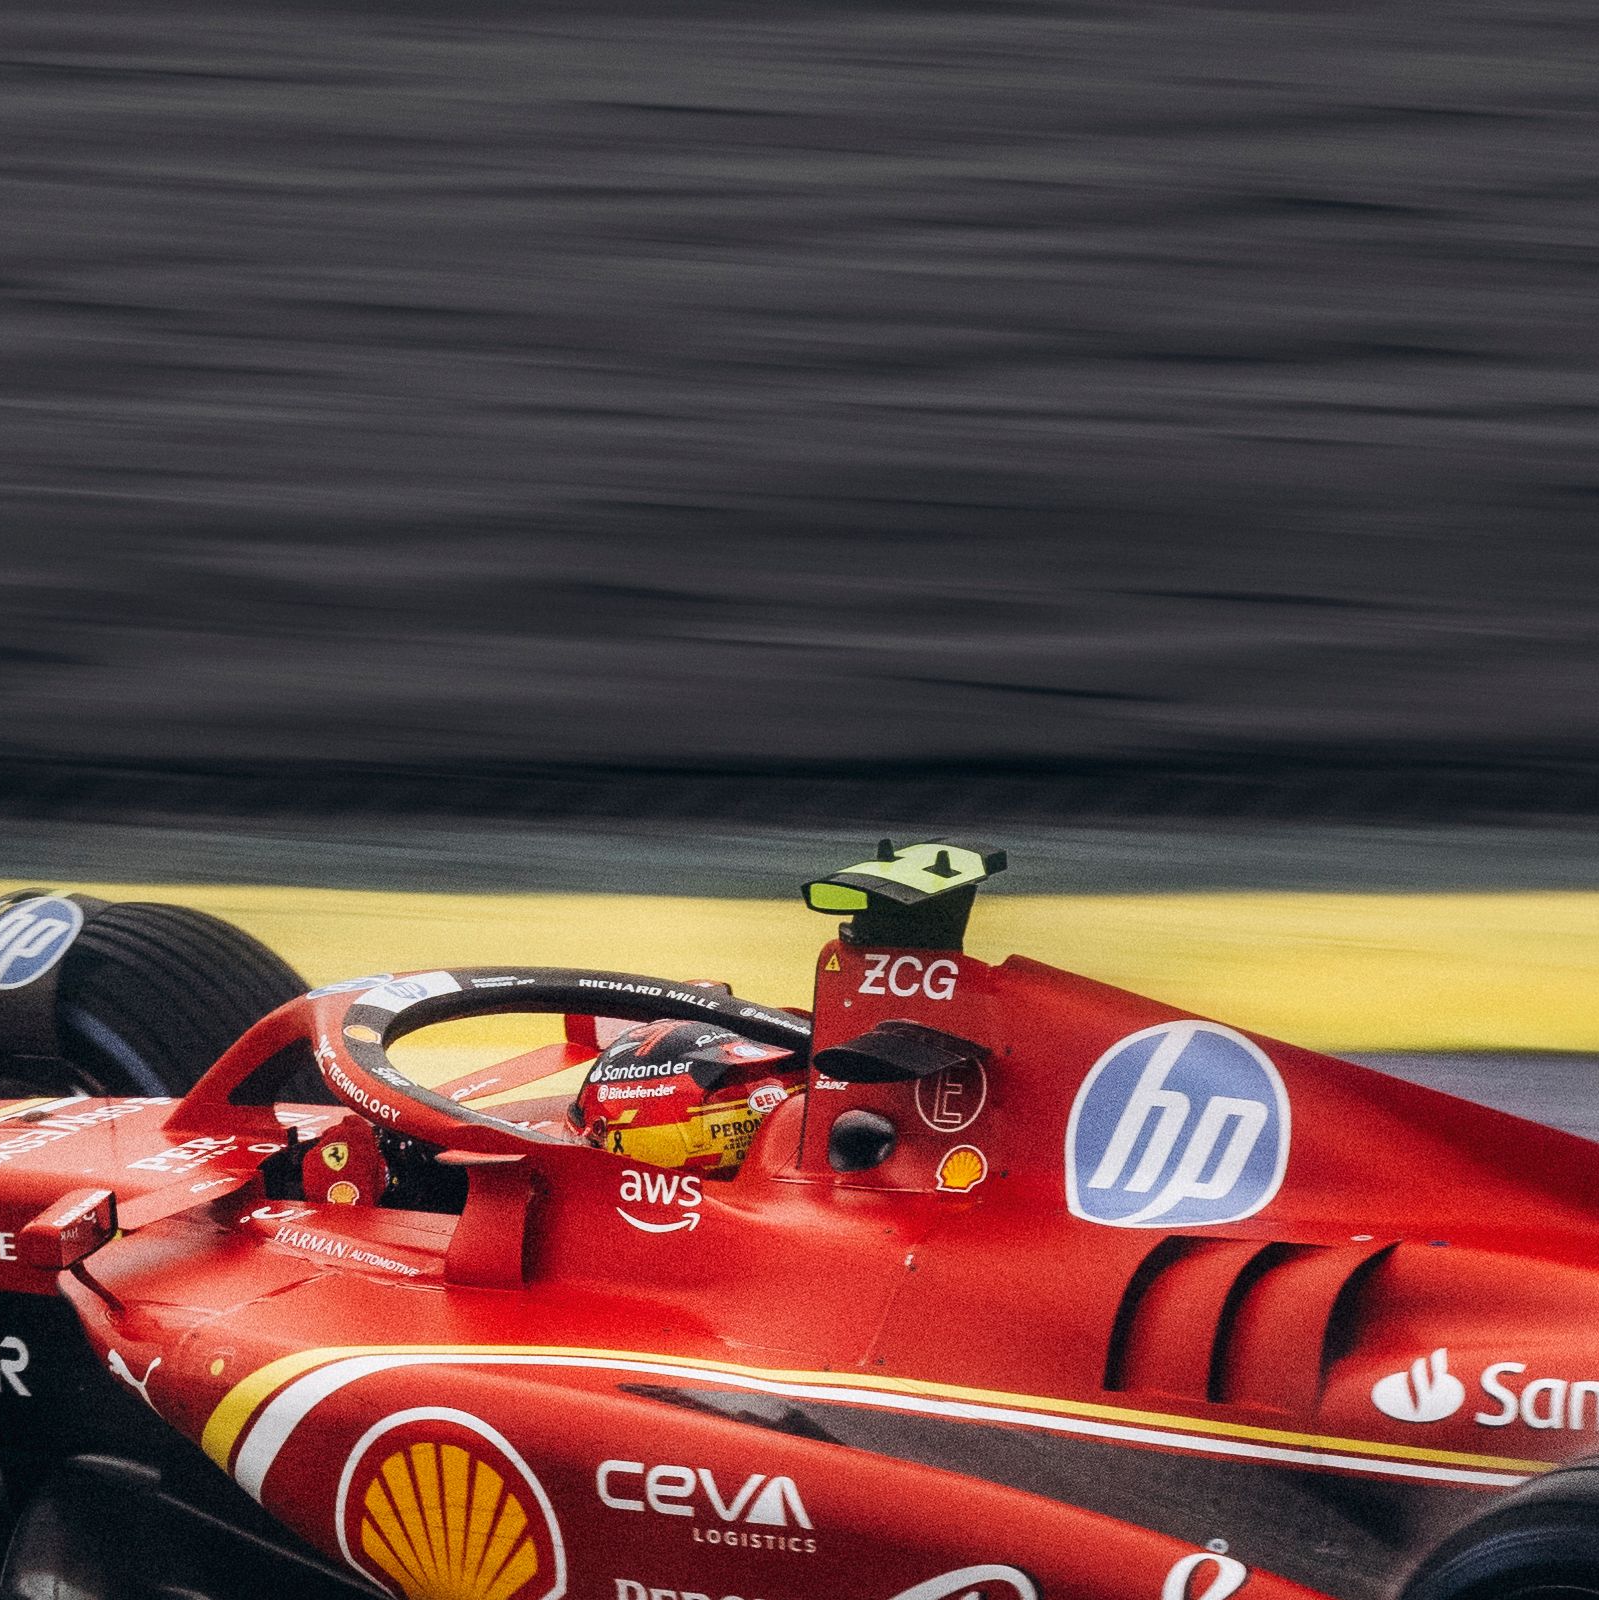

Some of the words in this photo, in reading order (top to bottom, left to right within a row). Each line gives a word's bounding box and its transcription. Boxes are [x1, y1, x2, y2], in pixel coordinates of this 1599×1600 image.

[579, 979, 662, 996] RICHARD
[666, 990, 720, 1010] MILLE
[601, 1061, 693, 1081] Santander
[328, 1062, 401, 1122] TECHNOLOGY
[607, 1084, 676, 1100] Bitdefender
[815, 1081, 849, 1091] SAINZ
[710, 1118, 763, 1139] PERON
[1080, 1022, 1274, 1226] hp
[619, 1169, 702, 1207] aws
[274, 1226, 348, 1259] HARMAN
[350, 1249, 420, 1277] AUTOMOTIVE
[692, 1527, 818, 1553] LOGISTICS
